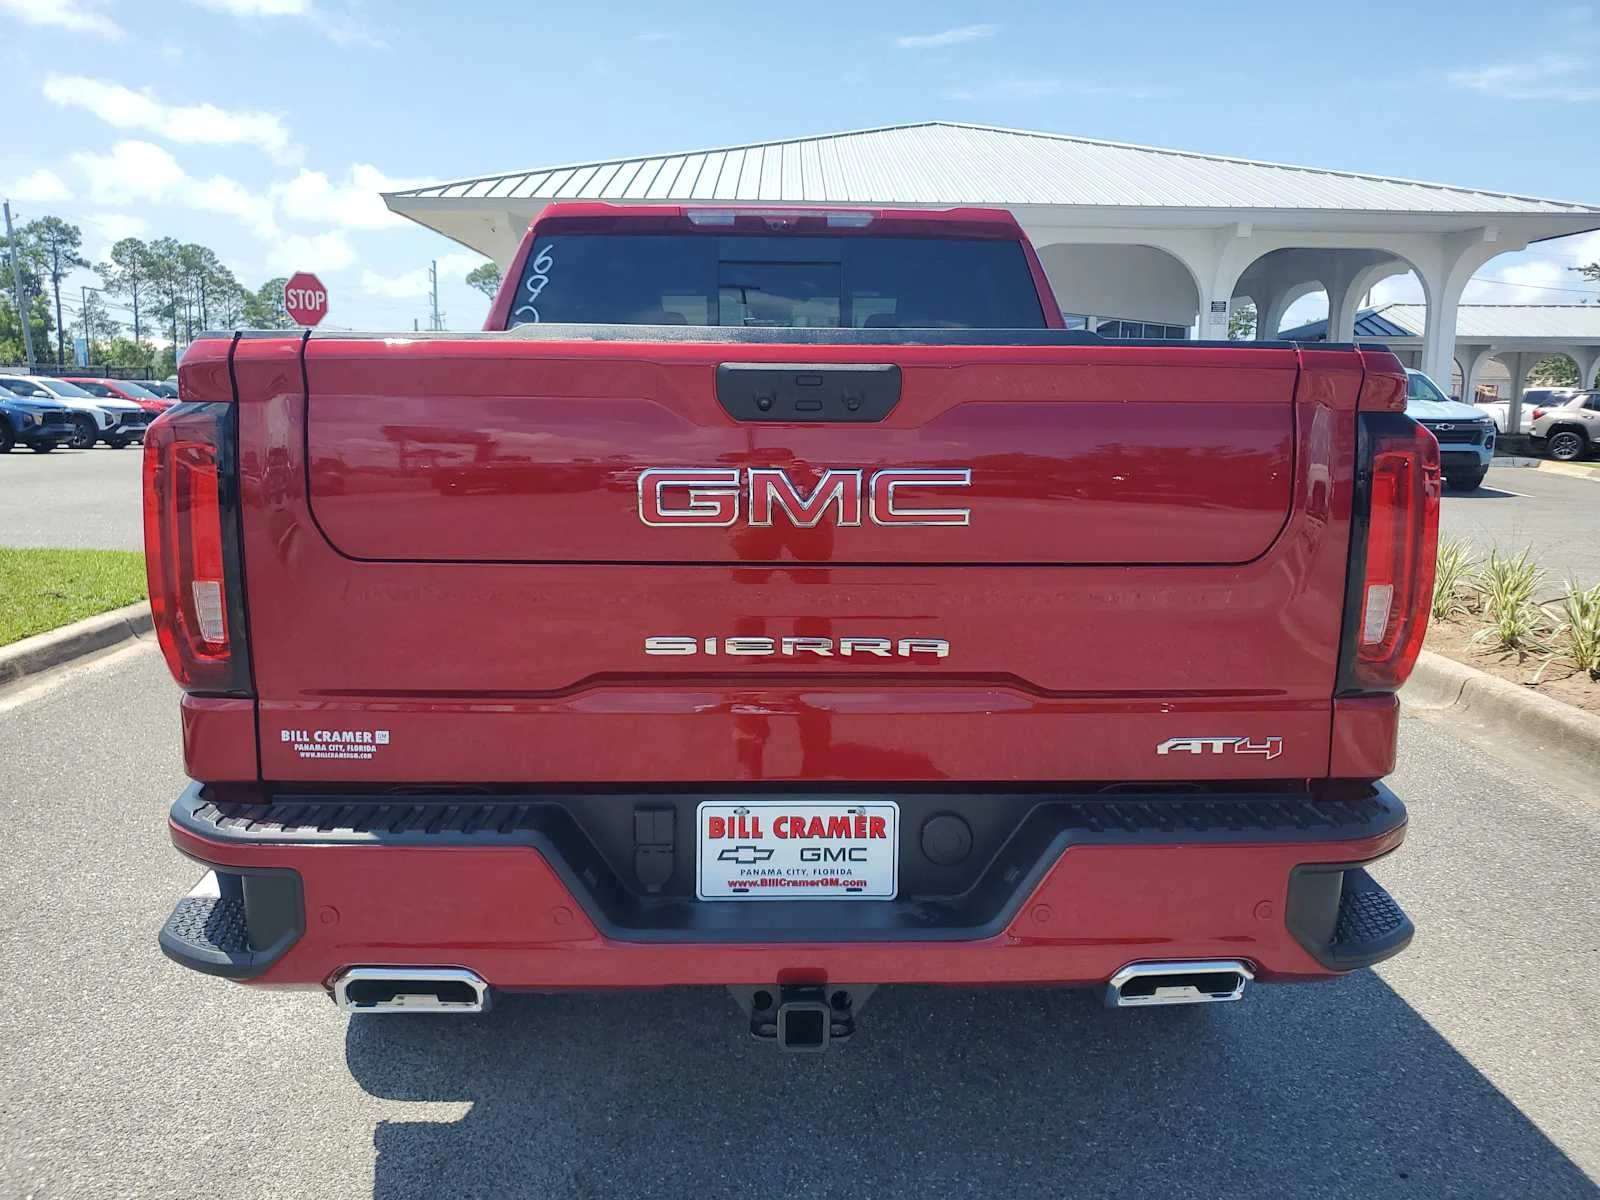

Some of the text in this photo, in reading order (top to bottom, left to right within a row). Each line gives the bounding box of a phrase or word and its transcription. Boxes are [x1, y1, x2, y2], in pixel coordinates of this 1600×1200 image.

[287, 288, 326, 311] STOP
[637, 467, 972, 528] GMC
[644, 636, 950, 658] SIERRA
[281, 729, 373, 743] BILL CRAMER
[294, 743, 377, 753] PANAMA CITY, FLORIDA
[1157, 736, 1282, 760] AT4
[708, 815, 887, 840] BILL CRAMER
[800, 847, 867, 862] GMC
[740, 868, 853, 878] PANAMA CITY, FLORIDA
[727, 877, 867, 889] www.BillCramerGM.com
